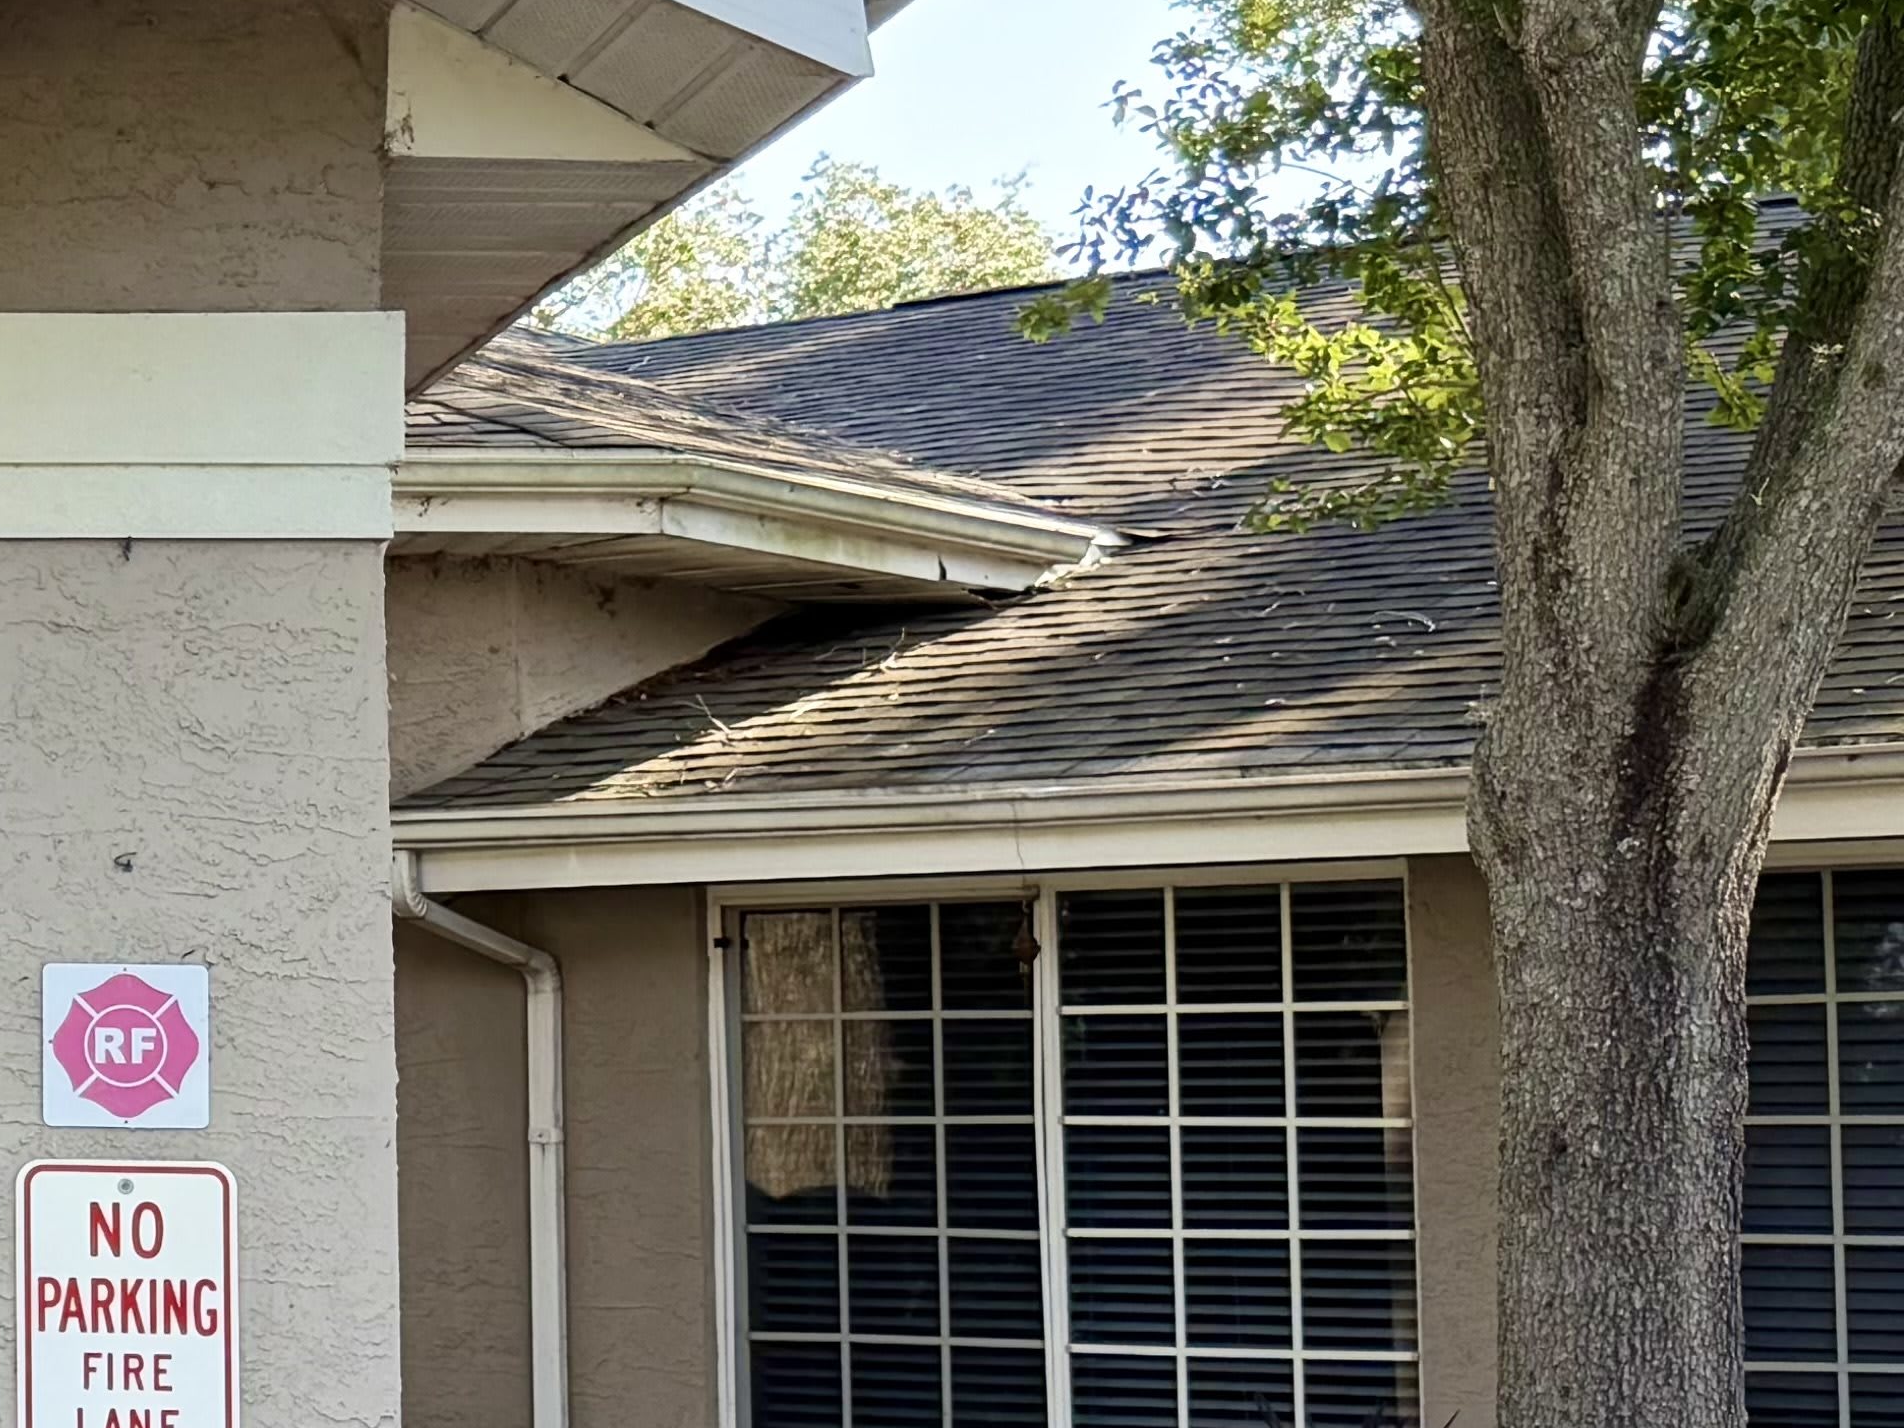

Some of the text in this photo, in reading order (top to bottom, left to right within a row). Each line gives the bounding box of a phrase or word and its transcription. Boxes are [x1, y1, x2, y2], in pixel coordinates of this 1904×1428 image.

[94, 1027, 156, 1064] RF
[89, 1202, 164, 1259] NO
[37, 1276, 217, 1337] PARKING
[83, 1352, 173, 1392] FIRE
